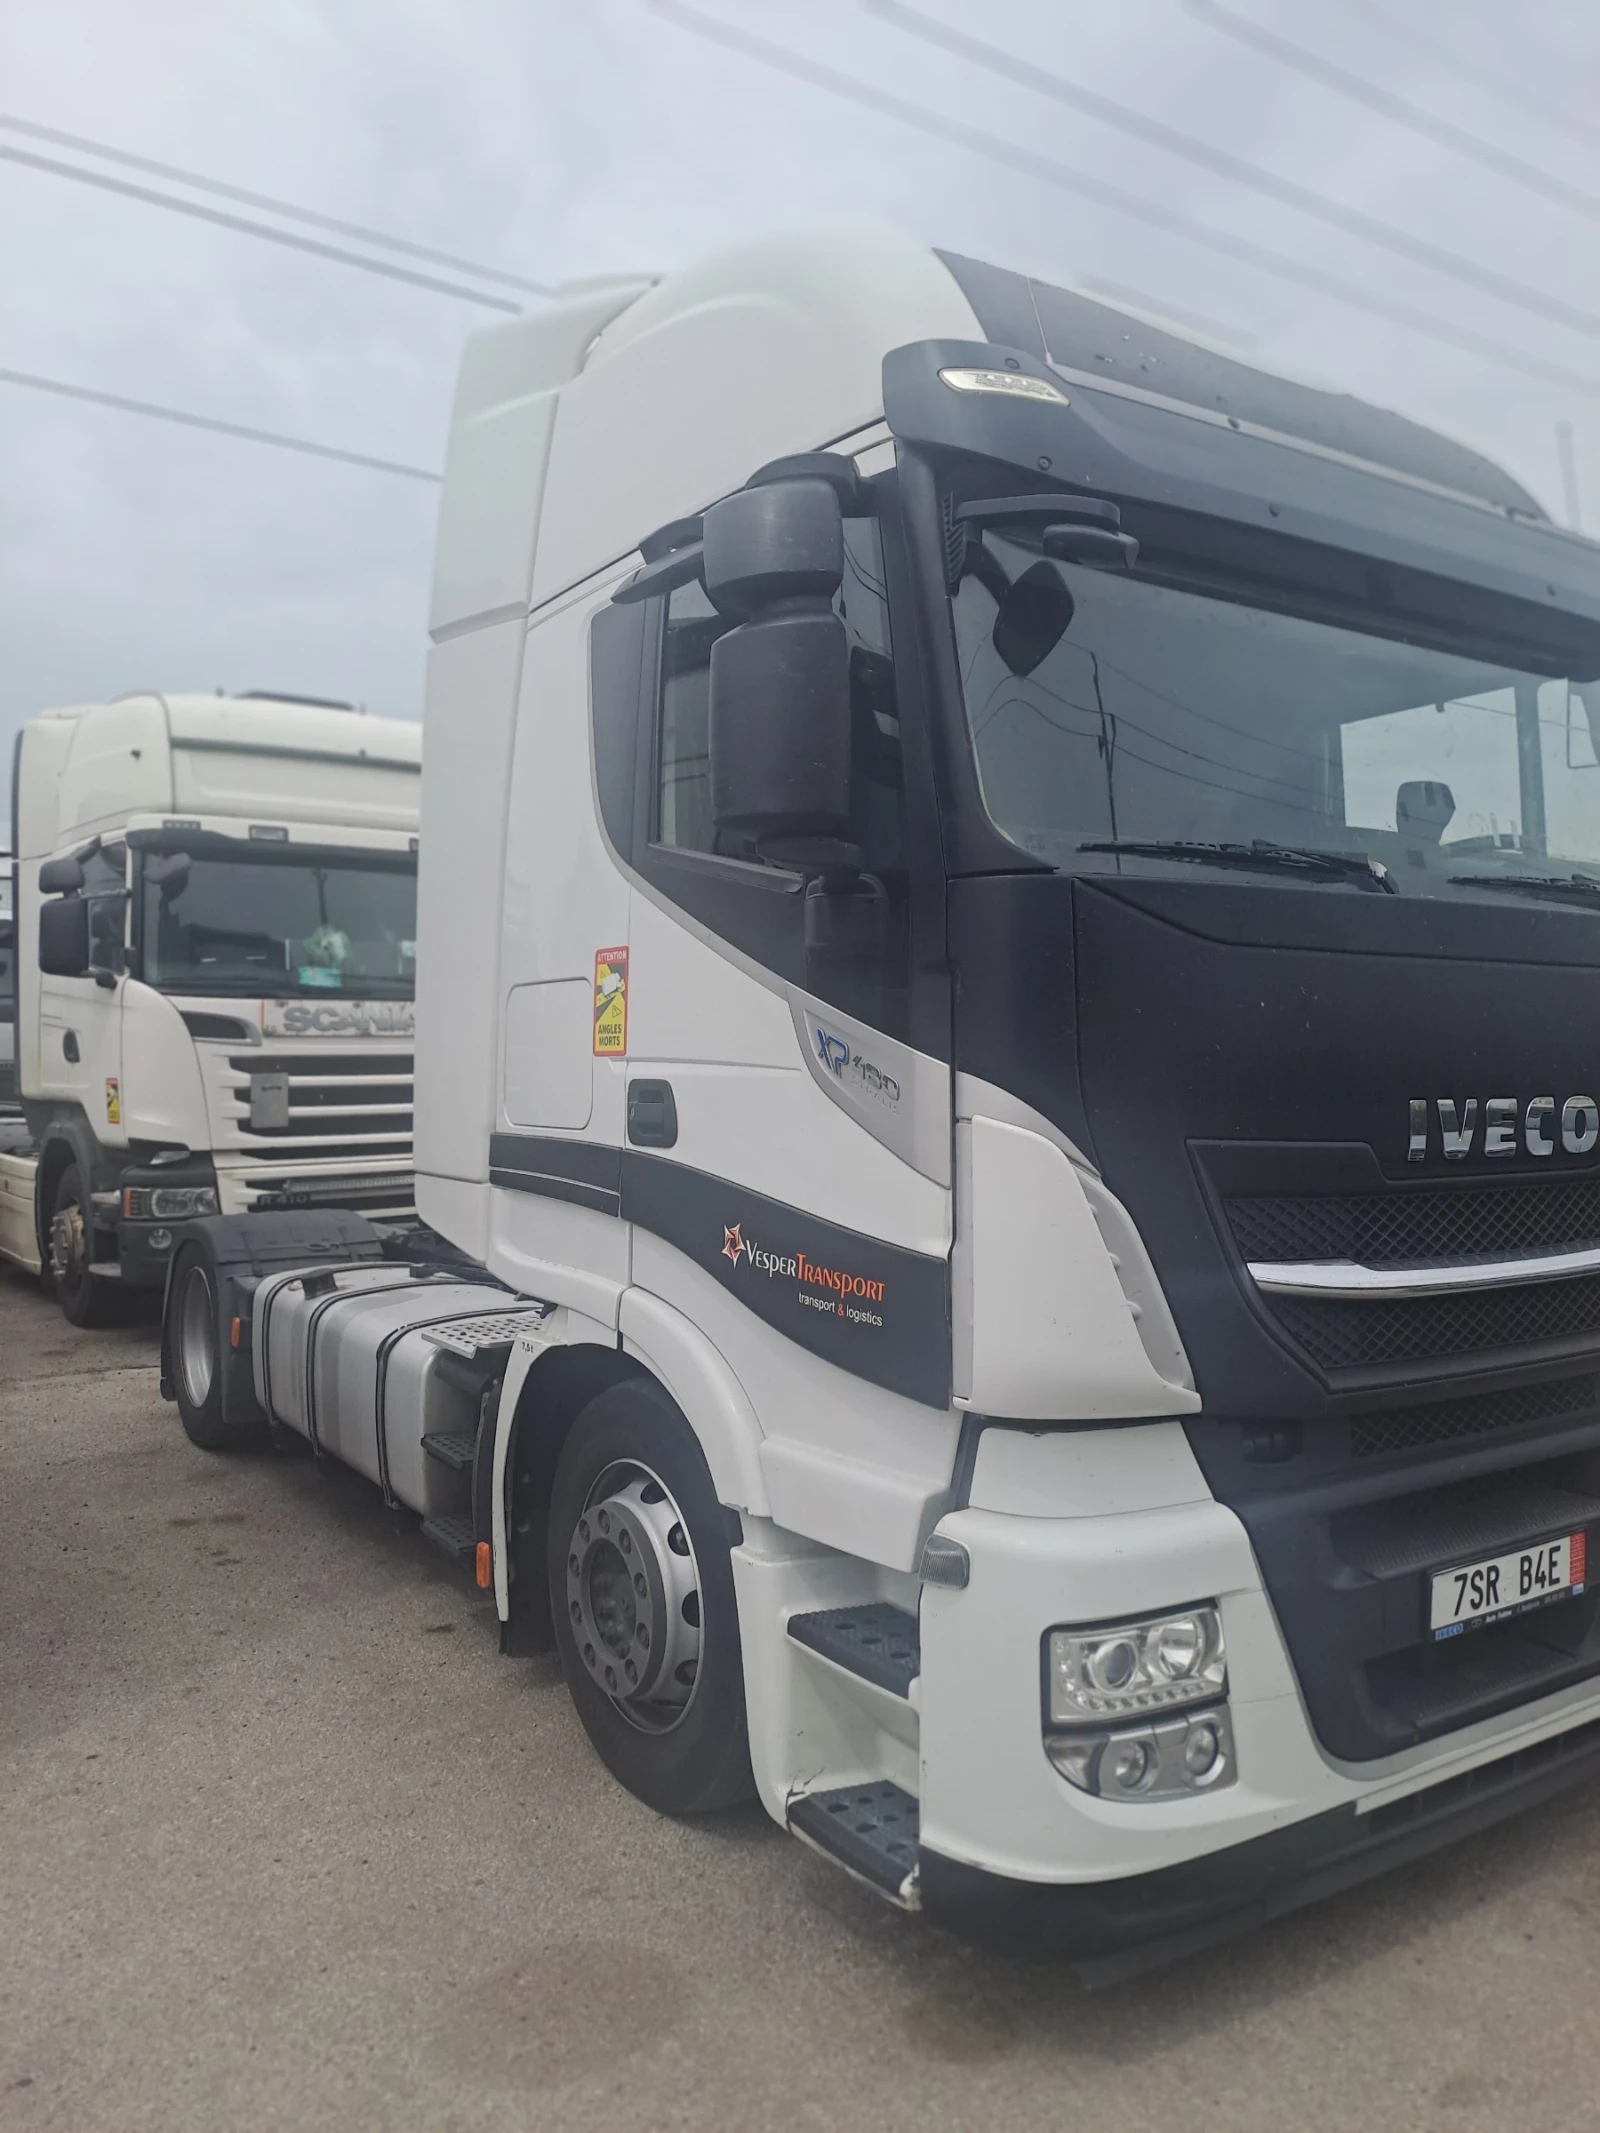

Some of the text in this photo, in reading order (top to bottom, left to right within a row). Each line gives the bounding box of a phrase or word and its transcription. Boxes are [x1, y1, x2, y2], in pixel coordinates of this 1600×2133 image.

[597, 950, 627, 961] ATTENTION
[598, 1024, 622, 1035] ANGLES
[598, 1035, 621, 1046] MORTS
[1408, 1095, 1599, 1162] IVECO
[798, 1292, 883, 1327] transport & logistics
[1454, 1564, 1500, 1617] 7SR
[1520, 1545, 1561, 1596] B4E
[1436, 1624, 1463, 1640] IVECO
